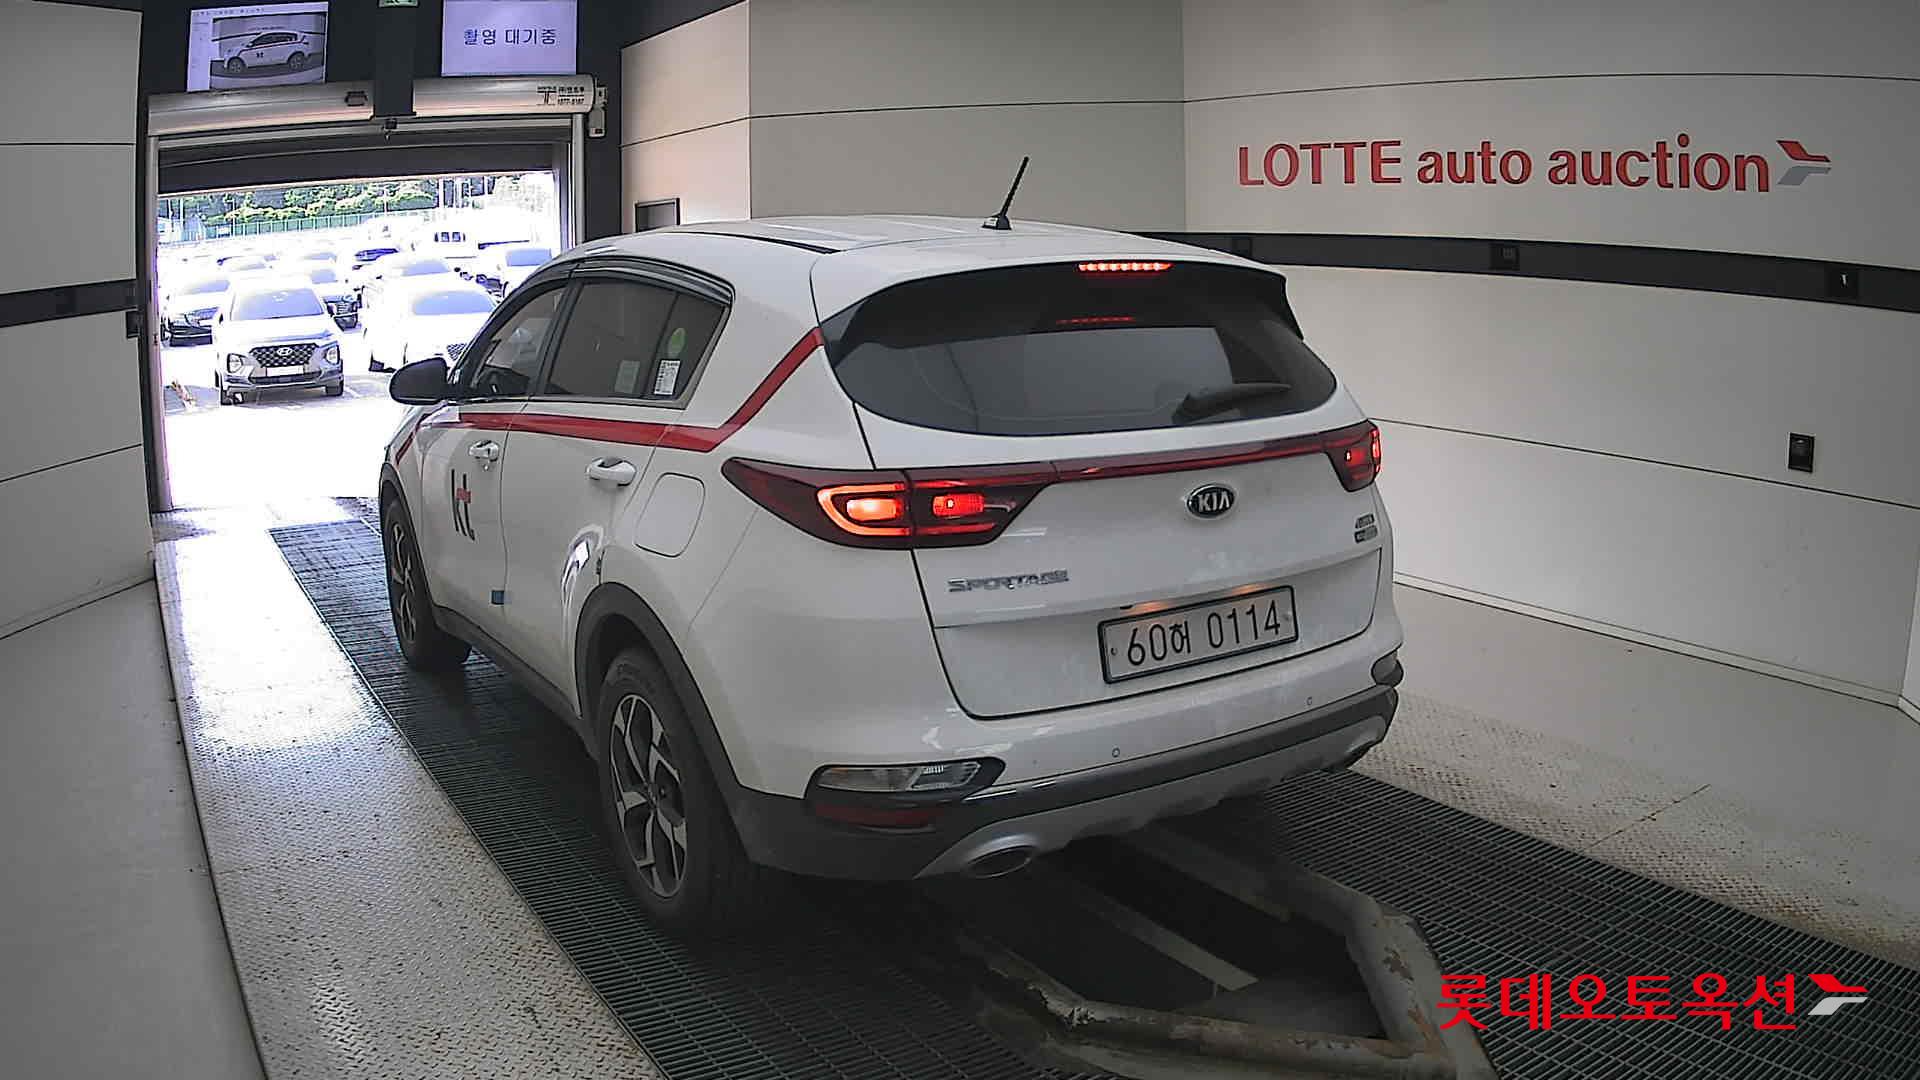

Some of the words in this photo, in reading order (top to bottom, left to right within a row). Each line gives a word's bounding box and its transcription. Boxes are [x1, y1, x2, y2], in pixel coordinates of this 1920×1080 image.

[464, 29, 496, 45] 촬영
[505, 29, 556, 45] 대기중
[1239, 140, 1402, 187] LOTTE
[1418, 141, 1532, 186] auto
[1548, 134, 1770, 193] auction
[1199, 490, 1230, 512] KIA
[1127, 620, 1191, 666] 60허
[1207, 600, 1282, 649] 0114
